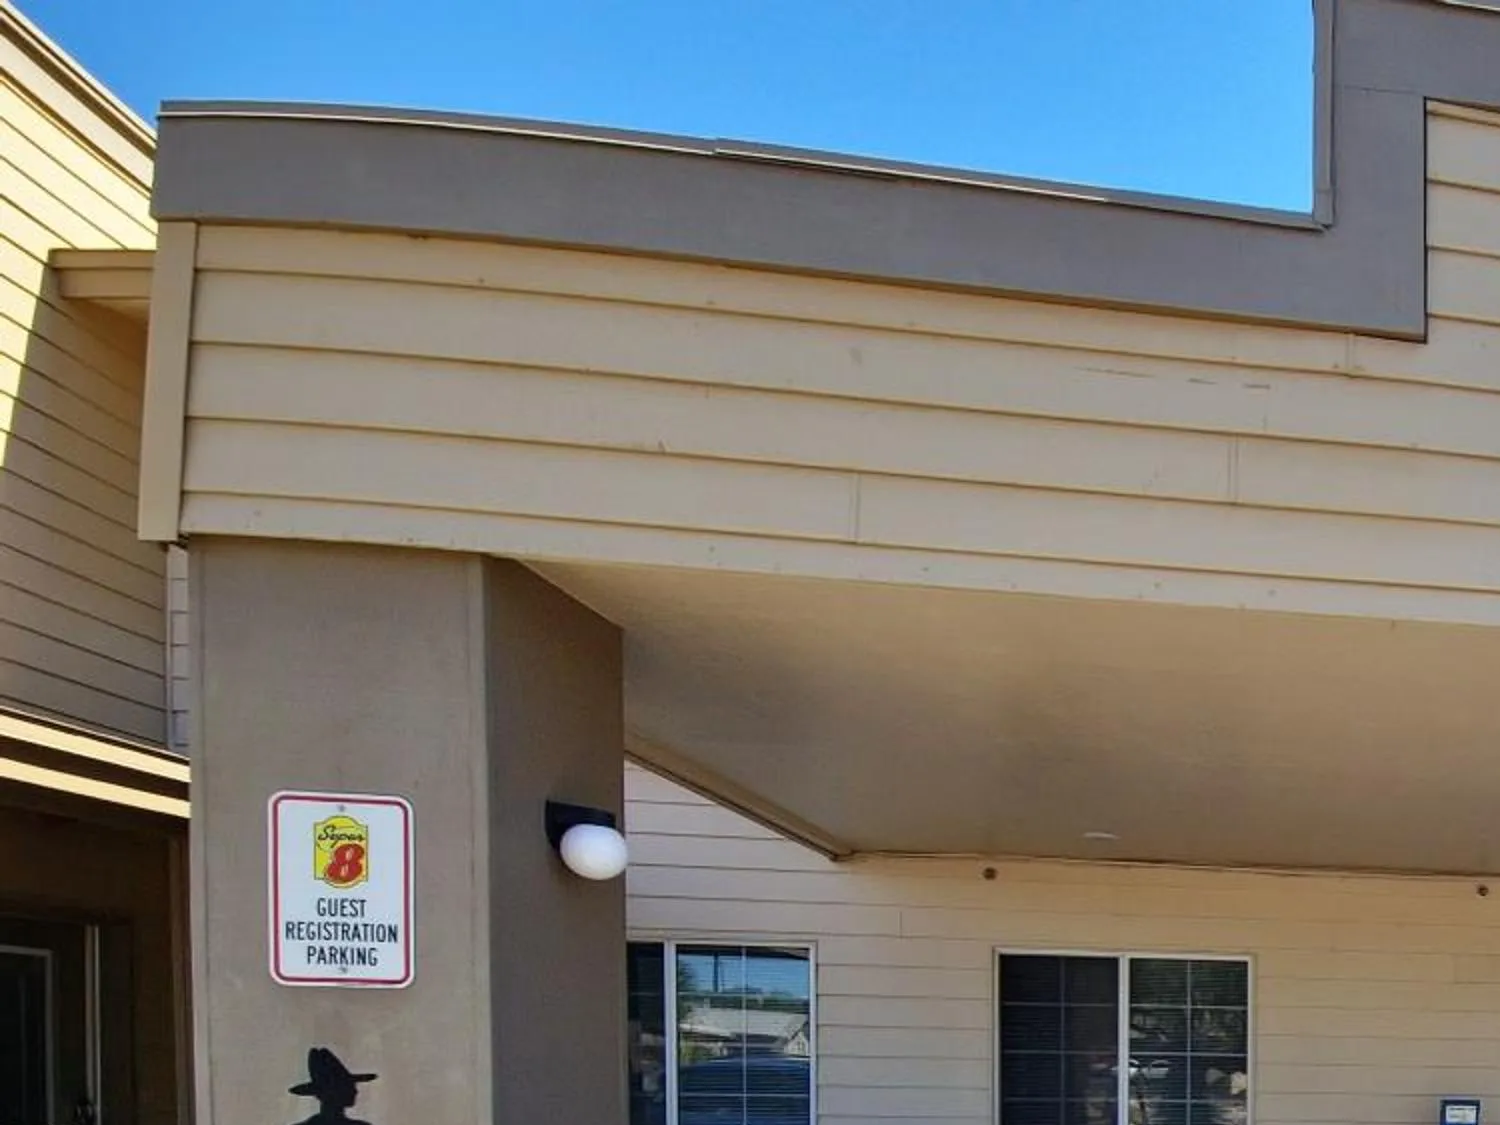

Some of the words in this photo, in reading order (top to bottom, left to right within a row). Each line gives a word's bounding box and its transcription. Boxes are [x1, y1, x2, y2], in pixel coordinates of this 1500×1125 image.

[318, 824, 366, 848] Super
[325, 843, 366, 884] 8
[316, 898, 367, 918] GUEST
[285, 921, 399, 943] REGISTRATION
[307, 946, 379, 966] PARKING
